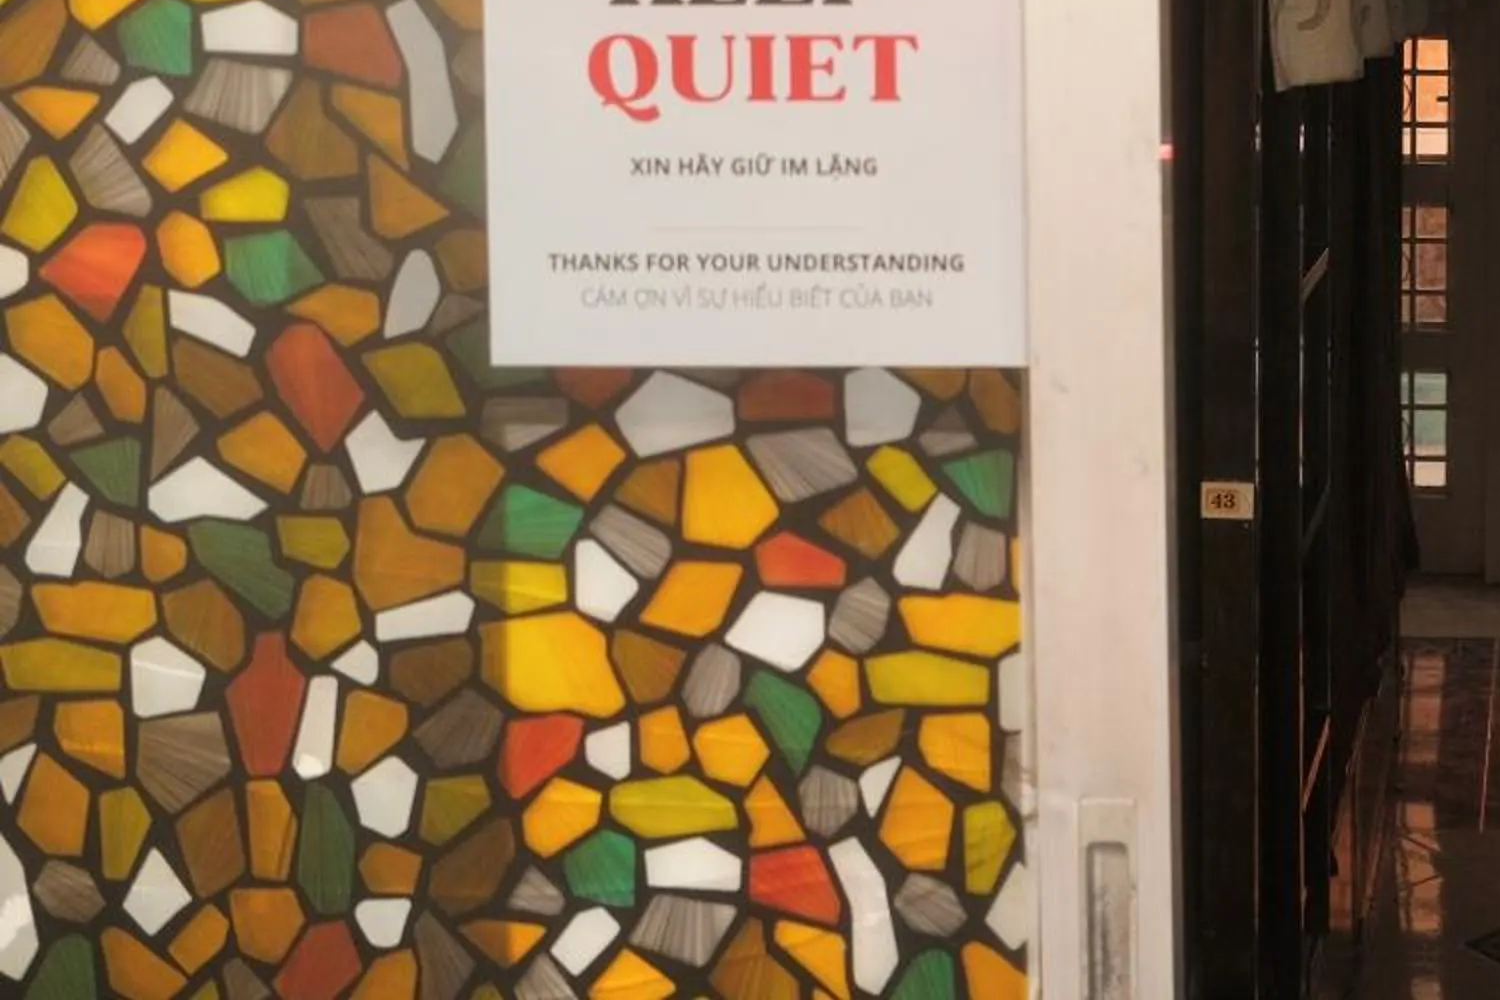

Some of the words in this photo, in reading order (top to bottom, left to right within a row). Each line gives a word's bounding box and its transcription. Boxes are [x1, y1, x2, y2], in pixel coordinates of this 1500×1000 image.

[587, 33, 920, 123] QUIET
[630, 157, 671, 176] XIN
[679, 152, 724, 176] HÃY
[730, 152, 776, 176] GIỮ
[781, 158, 808, 176] IM
[816, 152, 879, 181] LẶNG
[548, 253, 640, 273] THANKS
[646, 254, 690, 273] FOR
[696, 254, 760, 273] YOUR
[767, 254, 966, 274] UNDERSTANDING
[1211, 494, 1235, 509] 43
